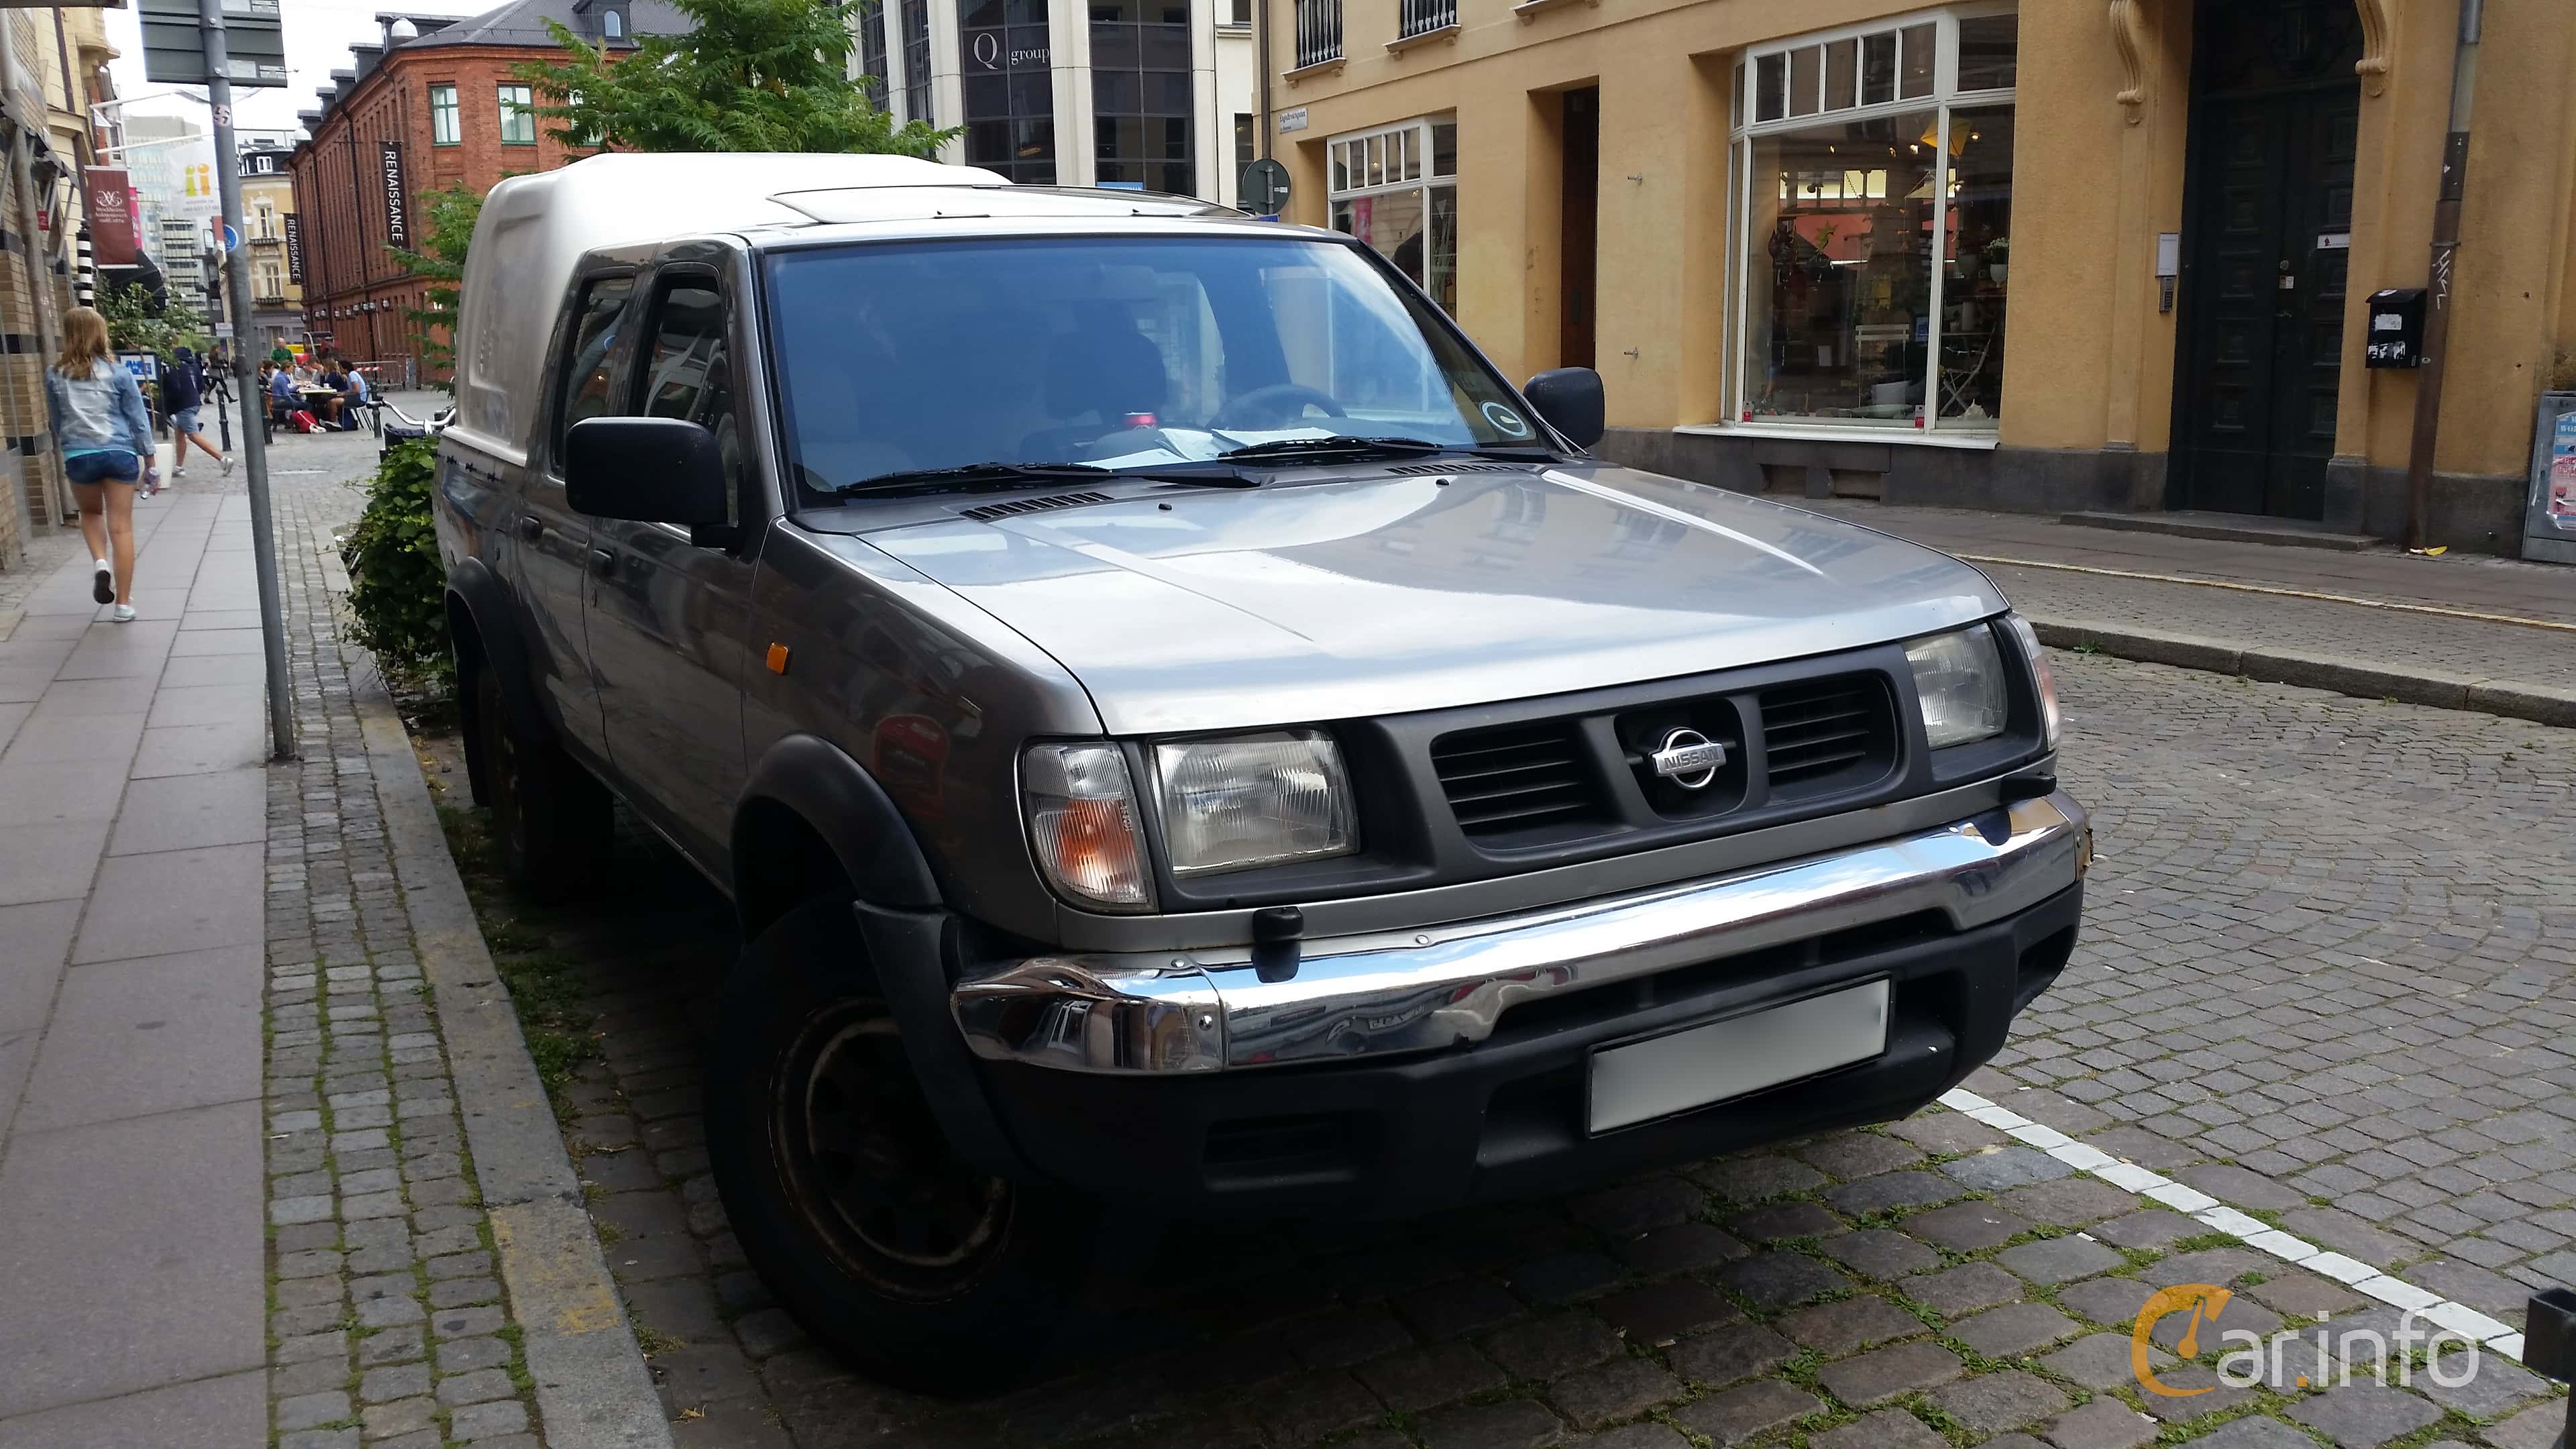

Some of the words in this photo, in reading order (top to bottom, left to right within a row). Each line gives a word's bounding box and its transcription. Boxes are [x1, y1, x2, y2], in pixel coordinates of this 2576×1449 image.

[974, 33, 998, 69] Q
[1011, 48, 1049, 65] group
[384, 151, 402, 241] RENAISSANCE
[287, 219, 301, 279] RENAISSANCE
[1664, 748, 1719, 770] NISSAN
